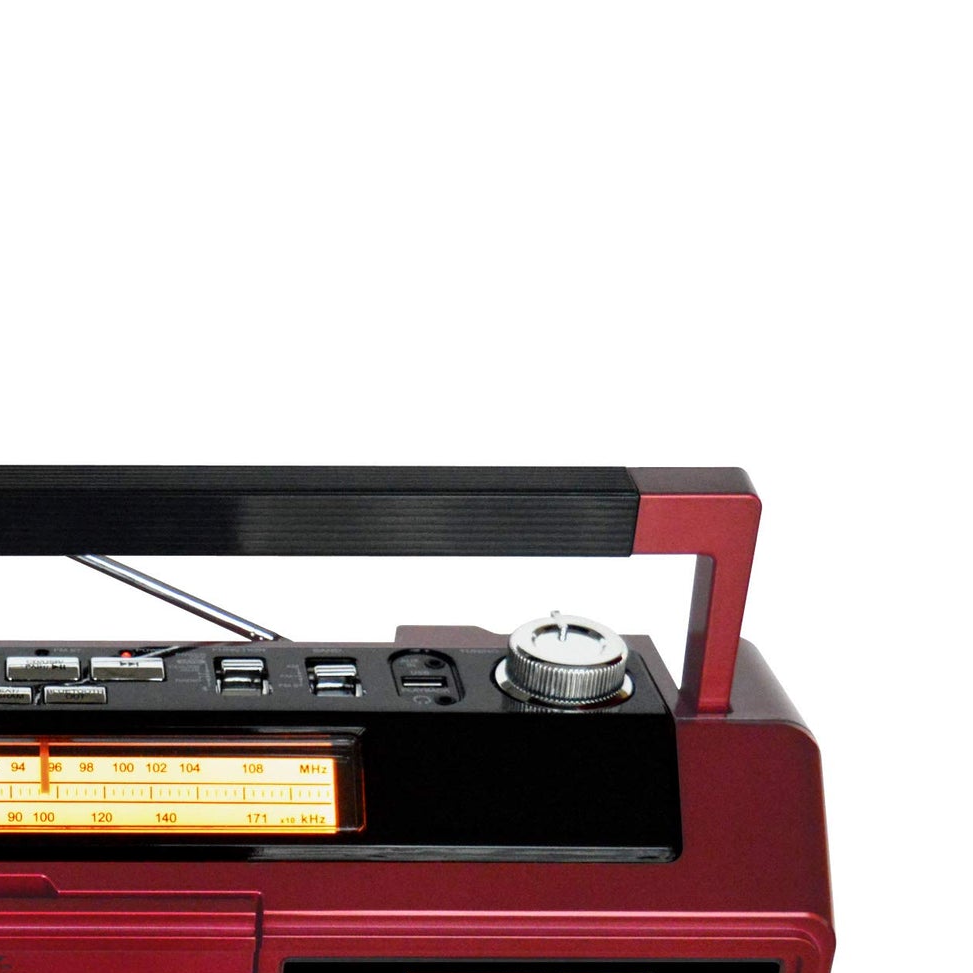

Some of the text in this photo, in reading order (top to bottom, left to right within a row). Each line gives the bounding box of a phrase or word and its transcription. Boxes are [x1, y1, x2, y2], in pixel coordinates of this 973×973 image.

[11, 762, 26, 772] 94
[48, 762, 62, 773] 96
[79, 762, 94, 773] 98
[112, 762, 134, 773] 100
[146, 762, 167, 773] 102
[179, 763, 200, 773] 104
[242, 763, 264, 774] 108
[299, 764, 327, 774] MHz
[7, 812, 23, 822] 90
[33, 812, 55, 822] 100
[91, 812, 113, 823] 120
[155, 813, 177, 823] 140
[246, 813, 268, 824] 171
[301, 814, 326, 824] kHz
